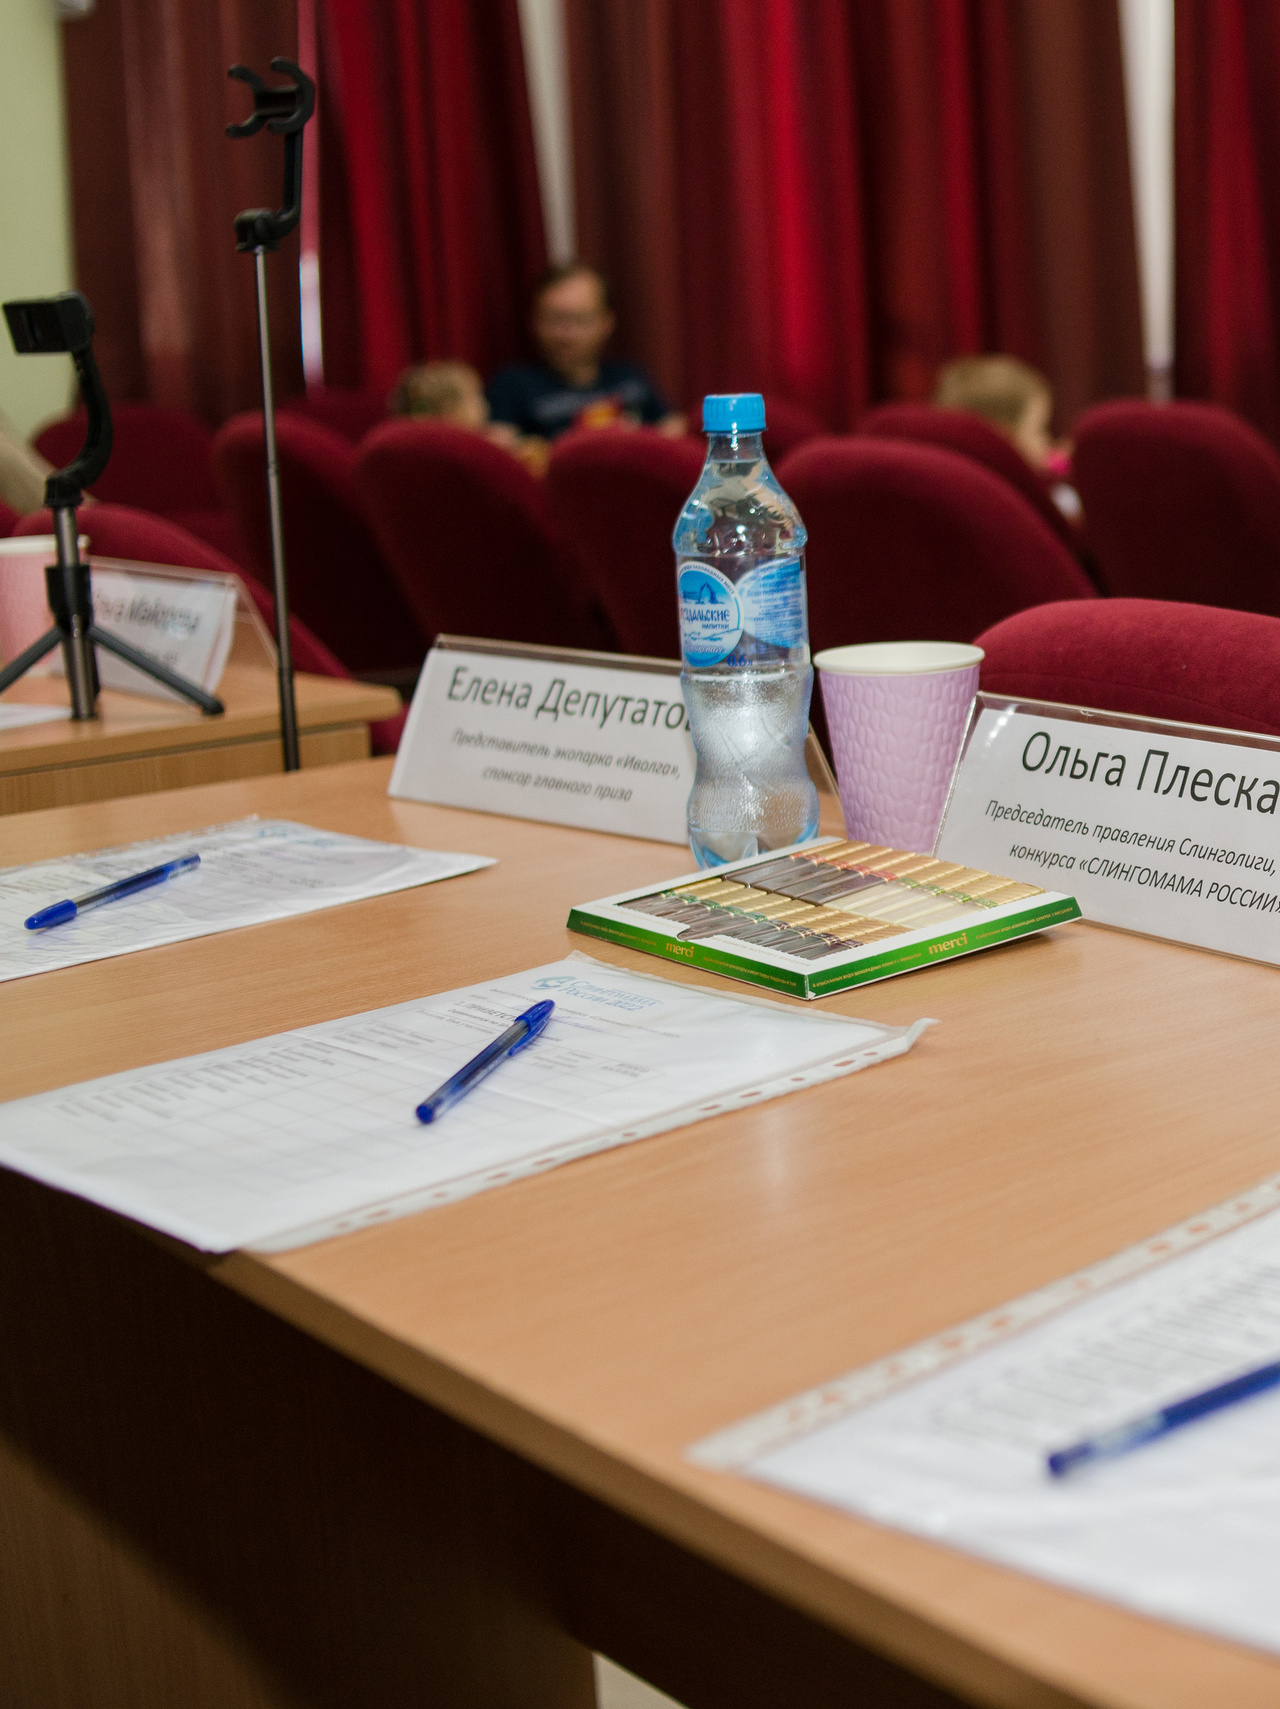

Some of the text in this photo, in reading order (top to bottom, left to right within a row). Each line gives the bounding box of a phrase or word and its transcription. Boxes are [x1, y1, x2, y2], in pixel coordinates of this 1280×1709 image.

[448, 665, 534, 711] Елена
[452, 727, 551, 758] Представитель
[552, 746, 613, 768] экопарка
[1021, 730, 1127, 788] Ольга
[482, 765, 633, 803] спонсор главного приза
[984, 799, 1090, 837] Председатель
[1092, 823, 1176, 854] правления
[1178, 837, 1277, 877] Слинголиги,
[1009, 843, 1076, 874] конкурса
[1078, 855, 1204, 899] «СЛИНГОМАМА
[665, 941, 695, 959] merci
[928, 932, 969, 956] merci
